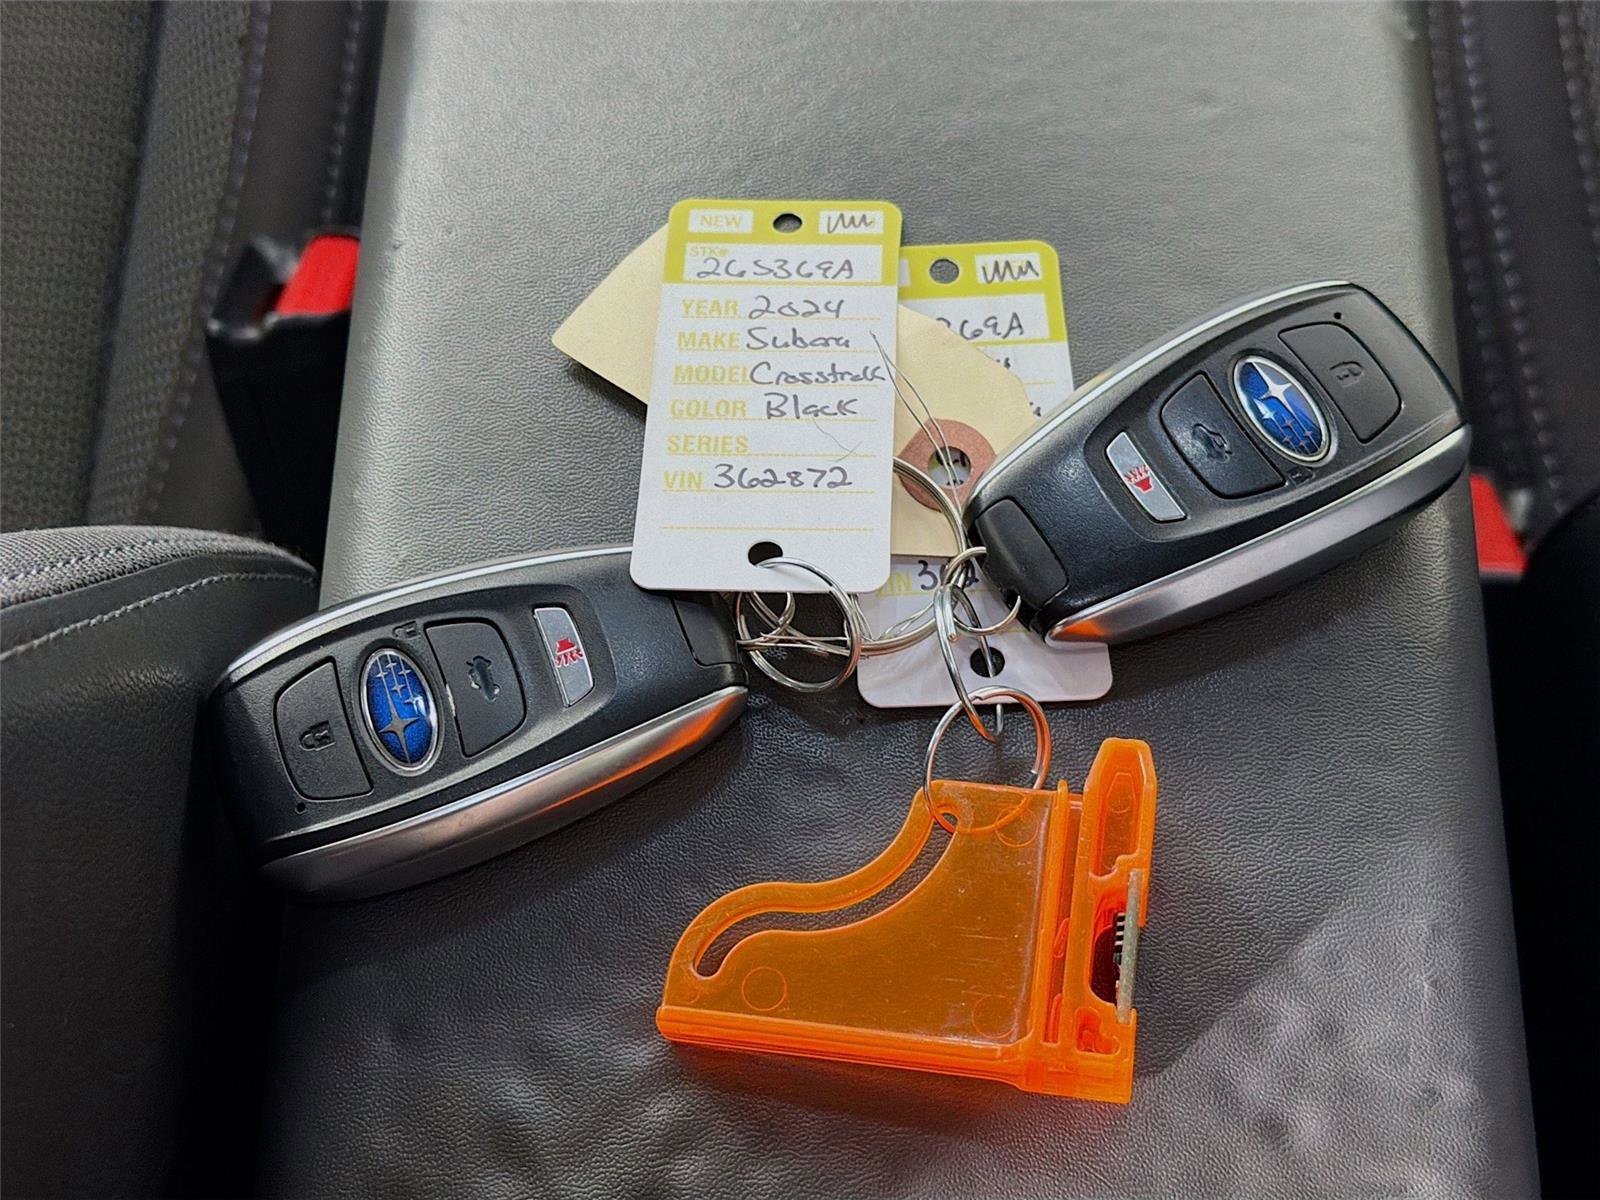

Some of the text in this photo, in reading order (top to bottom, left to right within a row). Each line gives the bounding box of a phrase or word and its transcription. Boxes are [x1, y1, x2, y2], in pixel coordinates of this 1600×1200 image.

[699, 214, 742, 227] NEW
[681, 298, 739, 317] YEAR
[748, 295, 845, 319] 2024
[677, 330, 740, 349] MAKE
[674, 364, 750, 384] MODEL
[670, 398, 747, 418] COLOR
[764, 392, 859, 420] Black
[666, 434, 749, 454] SERIES
[663, 470, 704, 490] VIN
[713, 463, 853, 489] 362872
